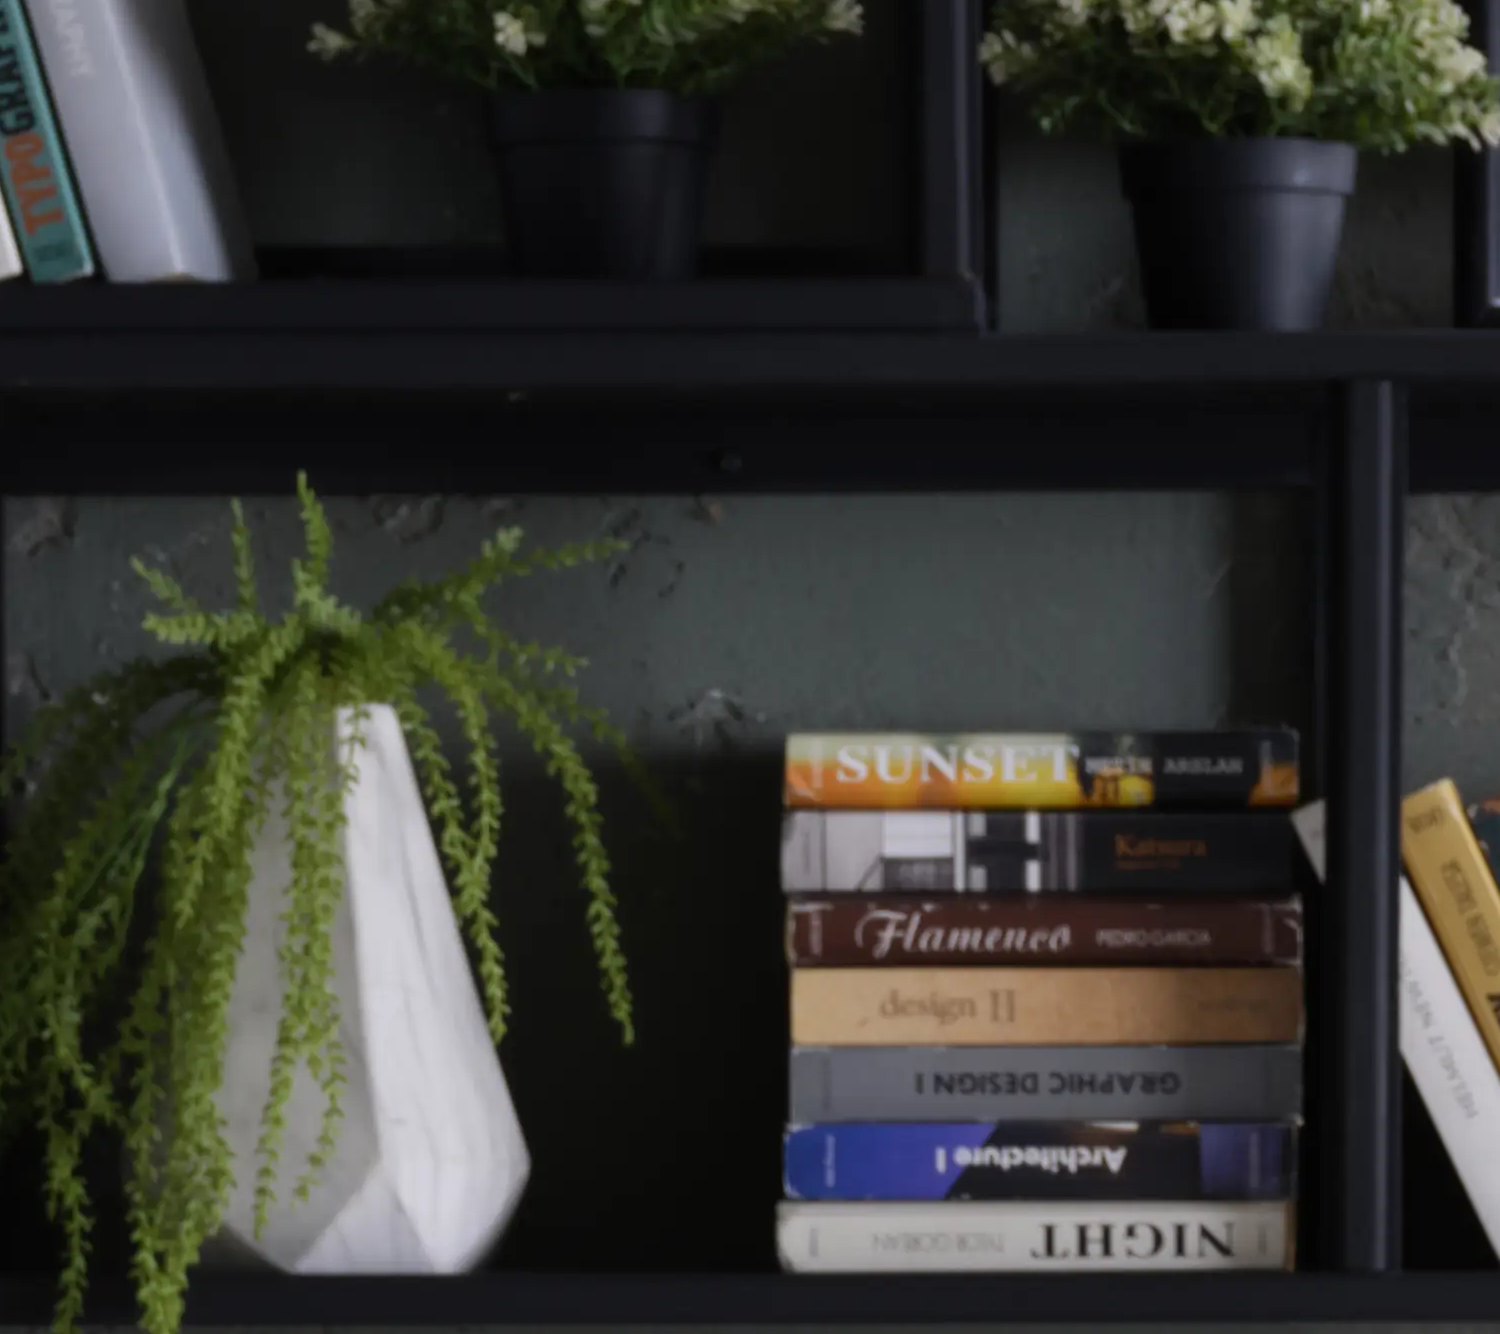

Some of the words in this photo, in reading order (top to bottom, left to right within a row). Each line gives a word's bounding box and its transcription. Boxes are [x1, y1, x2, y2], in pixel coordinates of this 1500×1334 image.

[835, 744, 1077, 785] SUNSET
[855, 909, 1073, 959] Flamenco
[880, 989, 976, 1025] design
[988, 990, 1016, 1024] II
[933, 1072, 1039, 1095] DESIGN
[1049, 1072, 1181, 1095] GRAPHIC
[953, 1145, 1127, 1174] Architecture
[1031, 1222, 1236, 1259] NIGHT
